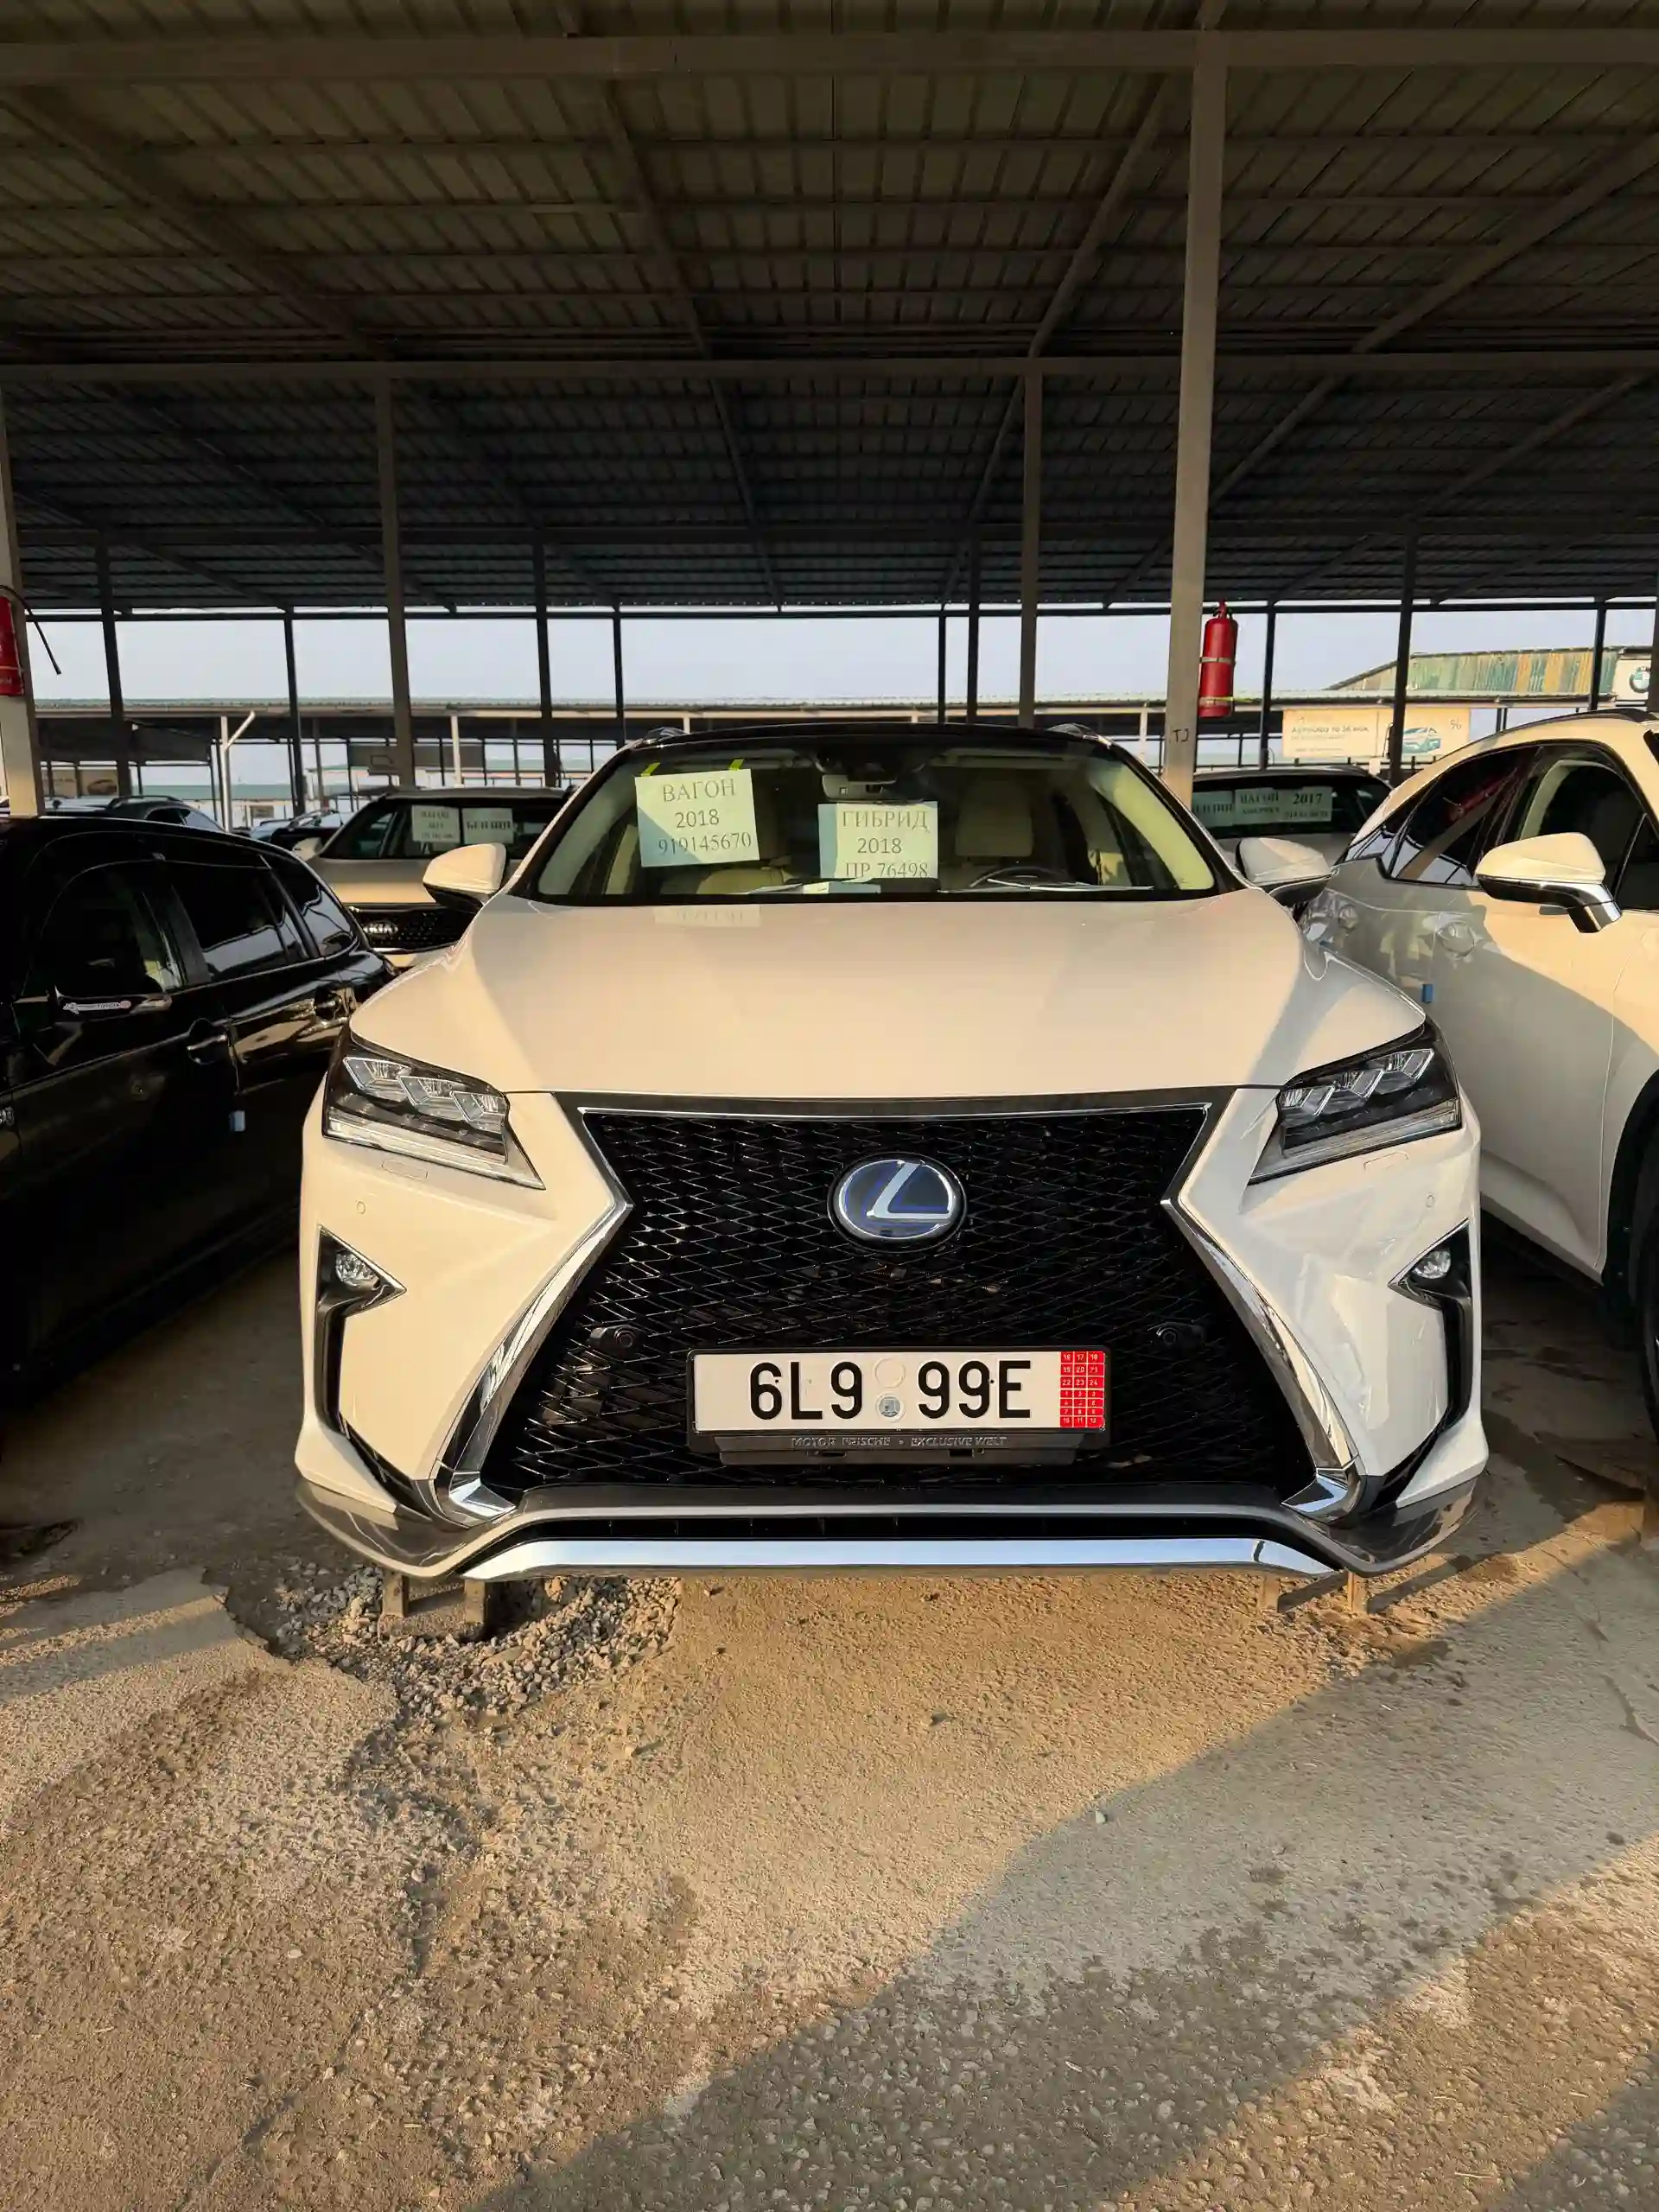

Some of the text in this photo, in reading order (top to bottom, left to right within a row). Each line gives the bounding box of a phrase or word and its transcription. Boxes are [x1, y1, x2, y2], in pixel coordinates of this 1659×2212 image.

[663, 778, 736, 803] ВАГОН
[1292, 792, 1324, 805] 2017
[674, 808, 720, 830] 2018
[841, 810, 931, 834] ГИБРИД
[658, 831, 752, 855] 919145670
[856, 837, 902, 855] 2018
[846, 862, 929, 878] ПР 76498
[750, 1359, 1031, 1421] 6L9 99E
[910, 1437, 973, 1447] EXCLUSIVE
